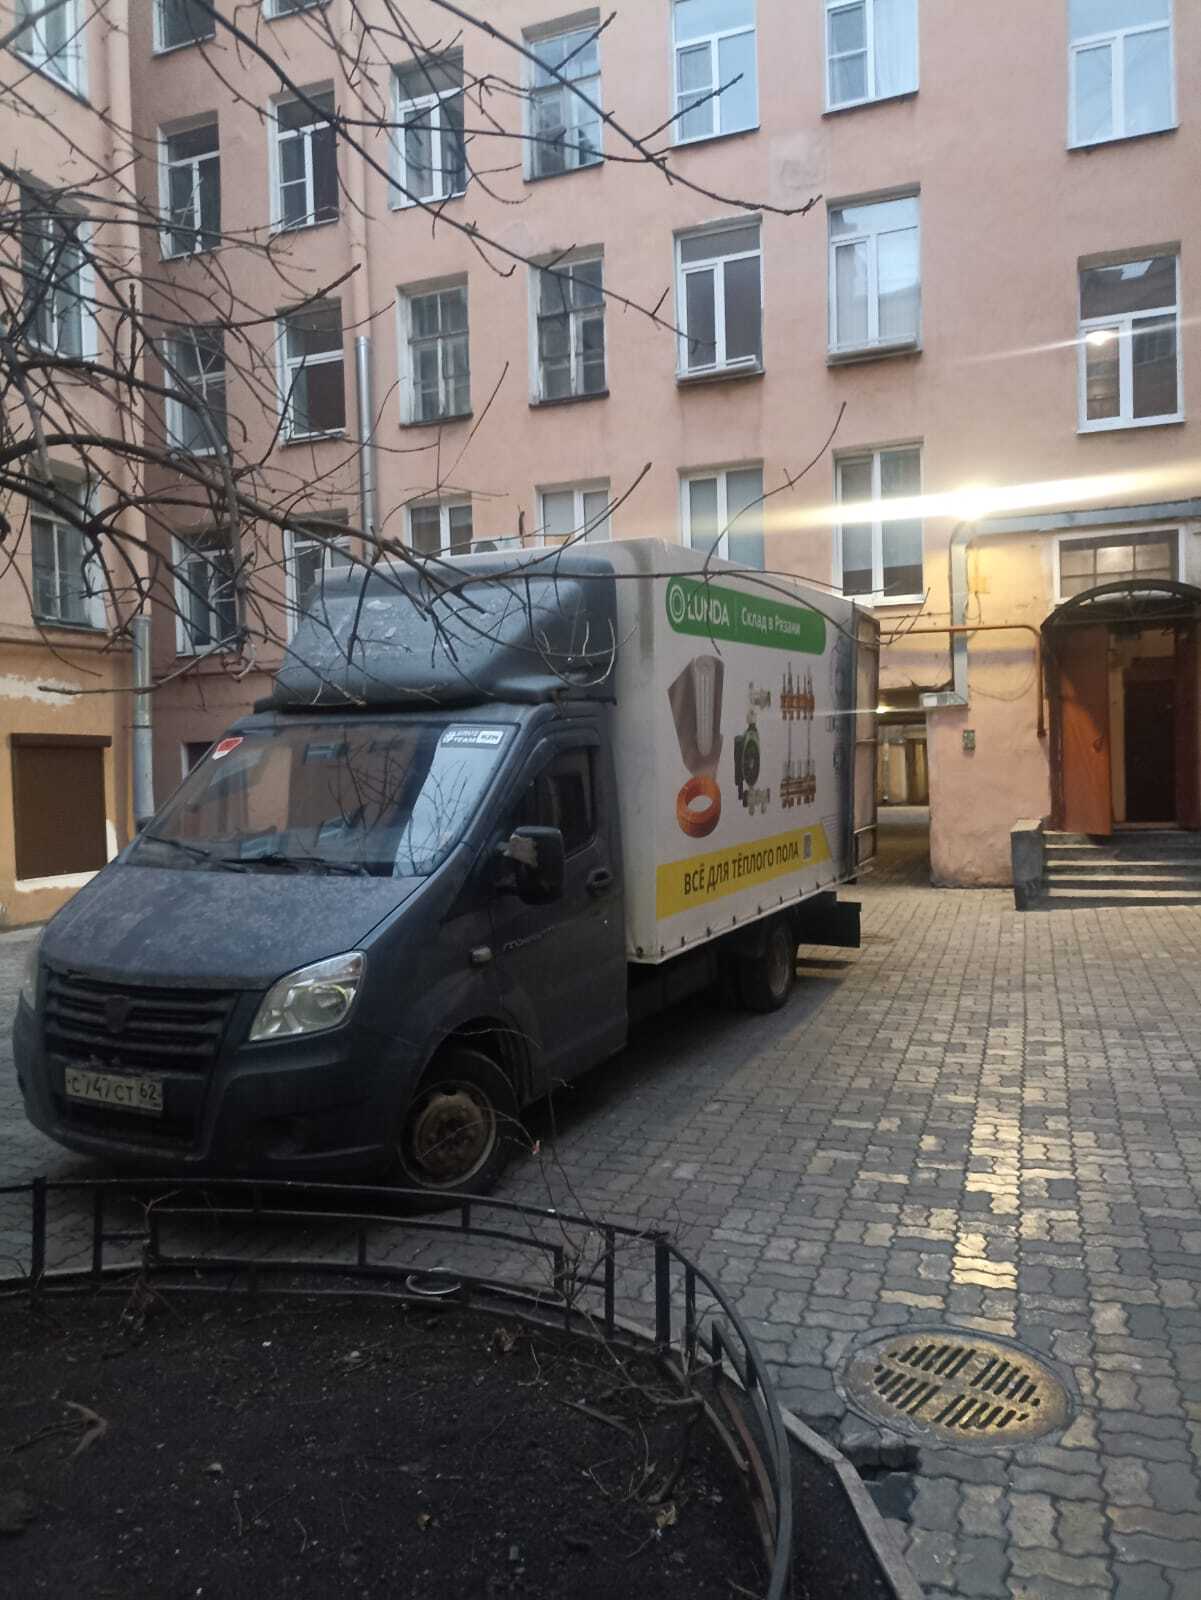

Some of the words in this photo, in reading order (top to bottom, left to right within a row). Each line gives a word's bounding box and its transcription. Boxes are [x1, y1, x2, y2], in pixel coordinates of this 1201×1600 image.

[687, 592, 730, 627] LUNDA
[741, 607, 768, 634] Склад
[684, 863, 705, 895] ВСЁ
[706, 864, 729, 894] ДЛЯ
[732, 848, 774, 878] ТЁПЛОГО
[776, 841, 799, 863] ПОЛА
